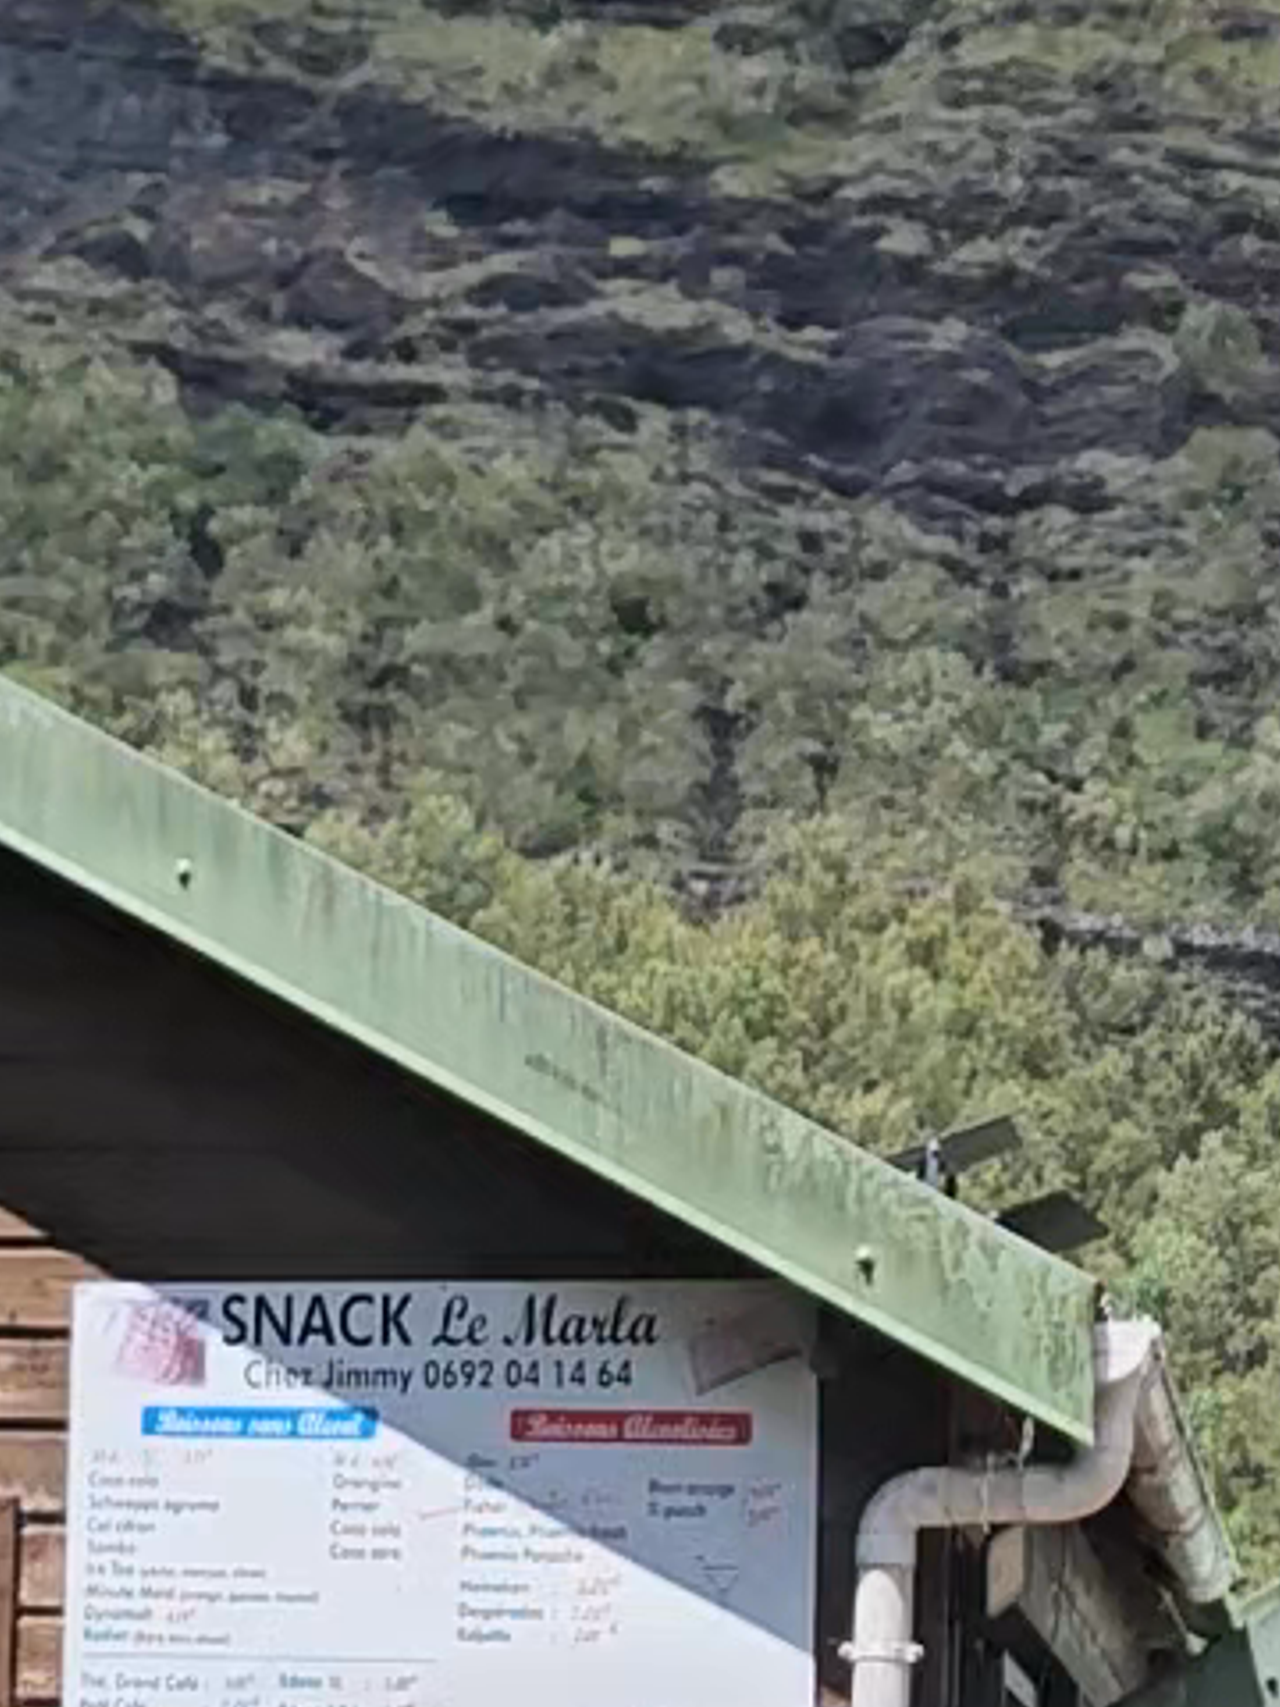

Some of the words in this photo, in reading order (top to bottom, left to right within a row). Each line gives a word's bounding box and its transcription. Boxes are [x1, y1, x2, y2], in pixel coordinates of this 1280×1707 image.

[221, 1293, 412, 1346] SNACK
[431, 1295, 489, 1346] Le
[504, 1295, 659, 1347] Marla
[245, 1360, 313, 1389] Chez
[320, 1360, 413, 1393] Jimmy
[424, 1360, 494, 1389] 0692
[505, 1360, 539, 1389] 04
[556, 1360, 587, 1389] 14
[598, 1360, 633, 1389] 64
[524, 1414, 617, 1437] Boissons
